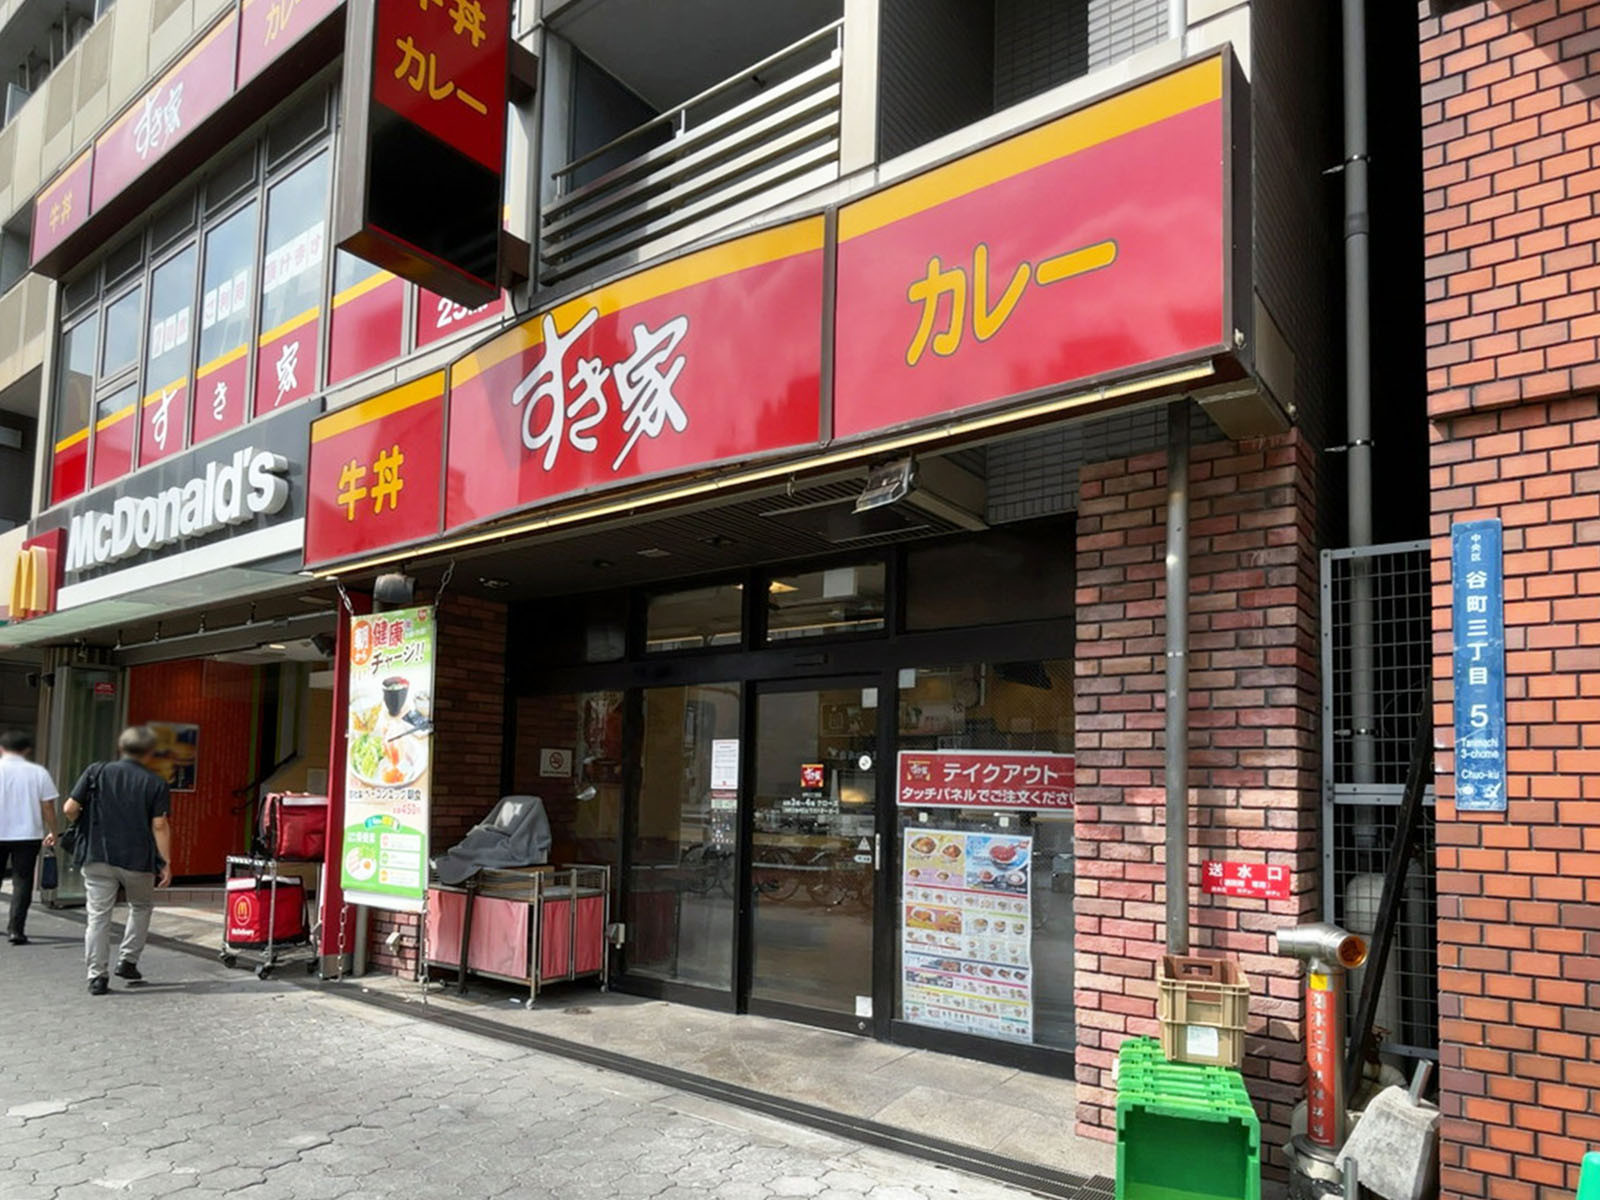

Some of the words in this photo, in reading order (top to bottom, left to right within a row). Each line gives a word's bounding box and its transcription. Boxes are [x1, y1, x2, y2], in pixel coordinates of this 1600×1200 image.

[419, 0, 486, 47] 丼
[394, 36, 488, 115] カレー
[134, 81, 184, 160] すき家
[905, 239, 1119, 366] カレー
[513, 307, 689, 471] すき家
[337, 444, 405, 521] 牛丼
[65, 446, 288, 573] McDonald's
[1471, 534, 1482, 562] 中央区
[373, 619, 405, 648] 健康
[1466, 570, 1488, 686] 谷町三丁目
[1470, 704, 1489, 728] 5
[943, 762, 1058, 785] テイクアウト
[1461, 748, 1499, 759] 3-chome
[1461, 768, 1500, 779] Chuo-ku
[1208, 862, 1282, 881] 送水口
